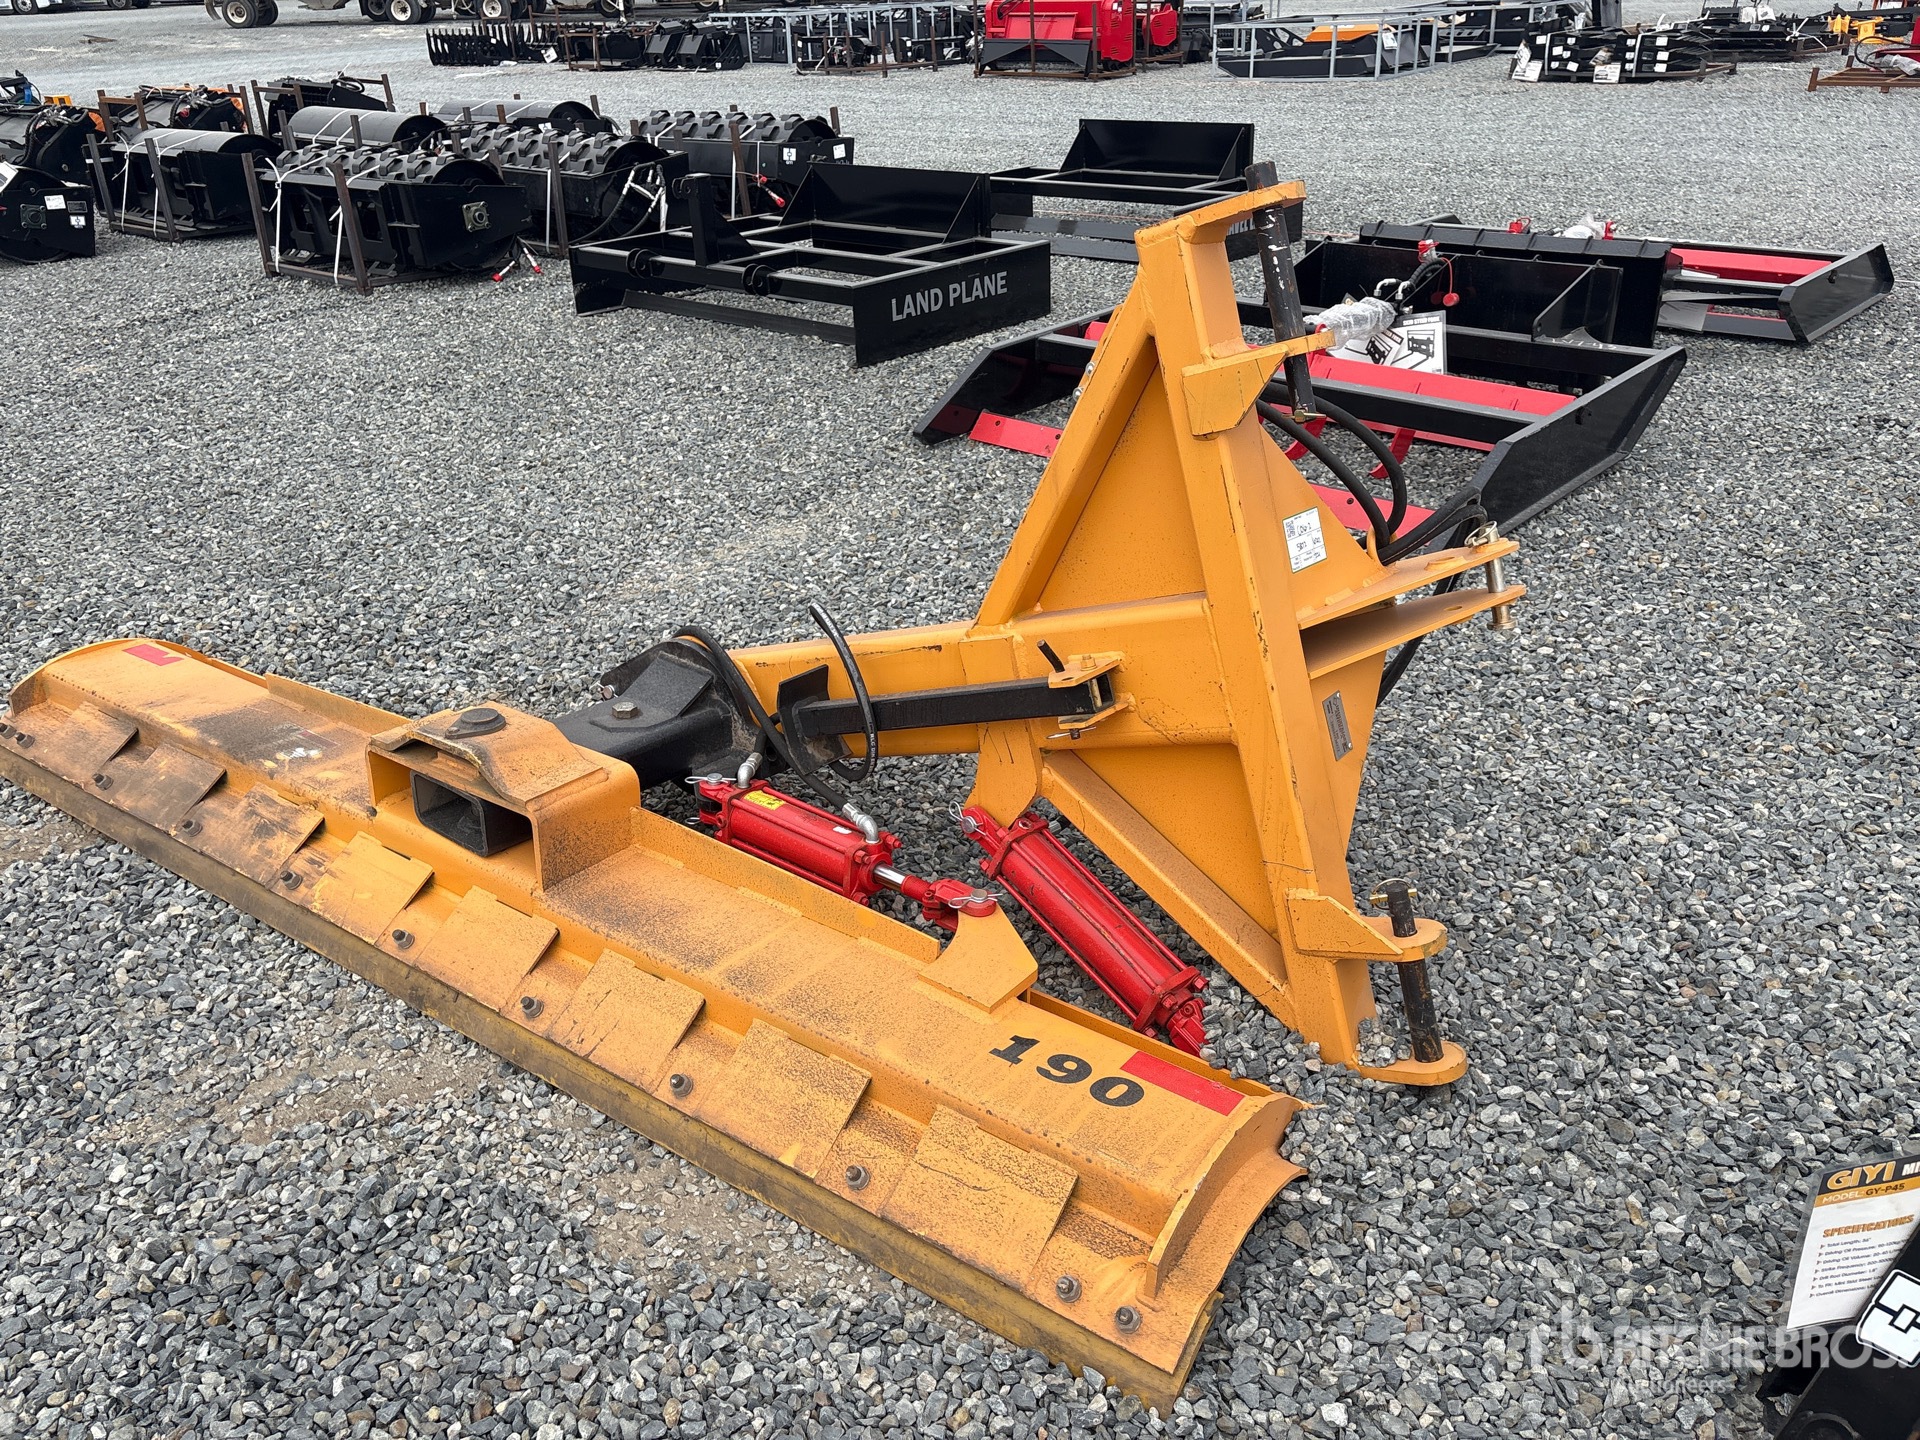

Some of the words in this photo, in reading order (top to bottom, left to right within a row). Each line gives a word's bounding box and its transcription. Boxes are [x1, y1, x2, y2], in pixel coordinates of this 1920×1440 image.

[891, 287, 943, 322] LAND
[948, 271, 1007, 307] PLANE
[988, 1034, 1145, 1107] 190
[1827, 1161, 1896, 1190] GIYI
[1822, 1190, 1864, 1204] MODEL:
[1865, 1183, 1906, 1196] GY-P45
[1822, 1214, 1915, 1238] SPECIFICATIONS
